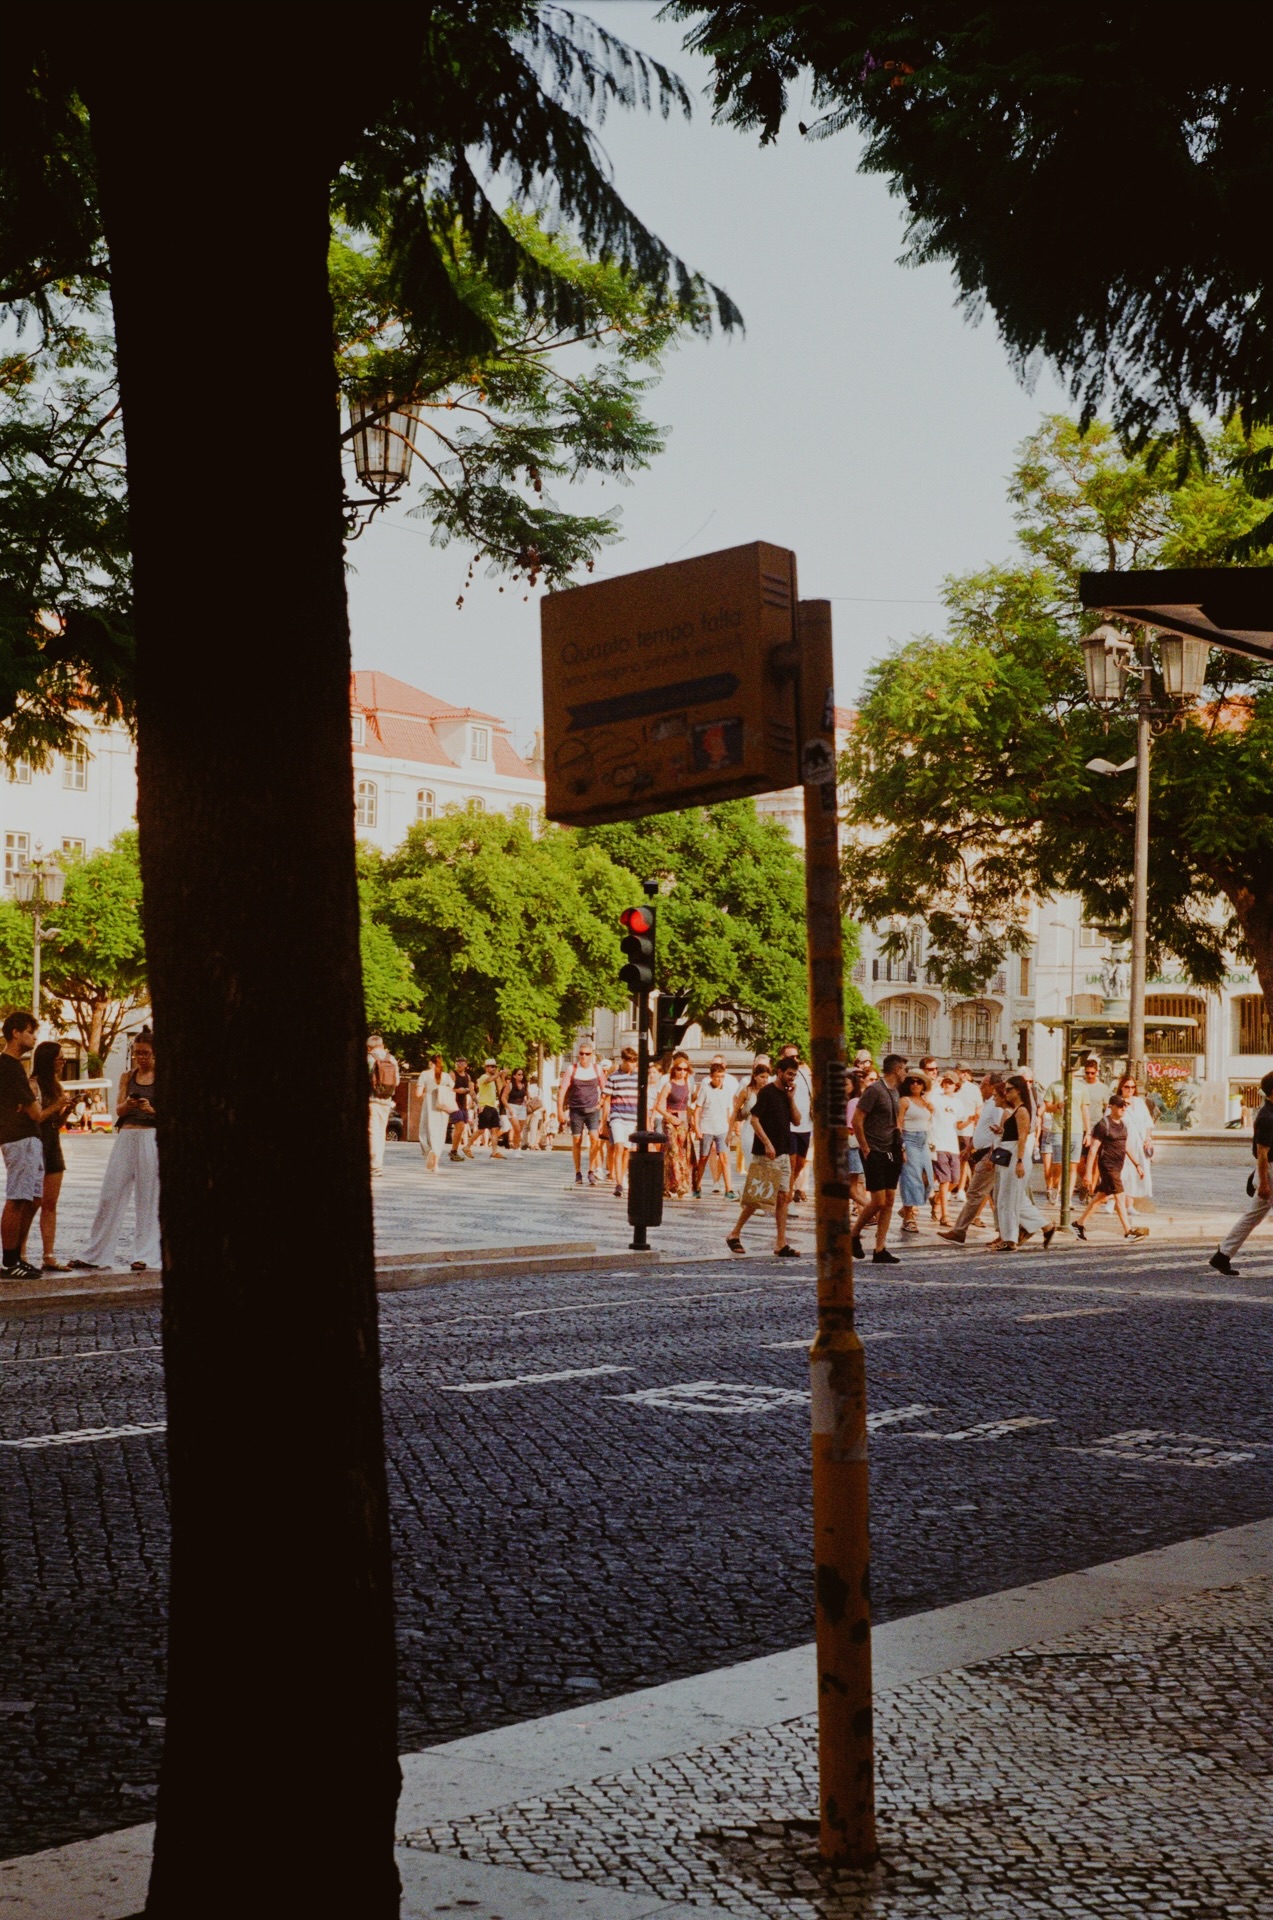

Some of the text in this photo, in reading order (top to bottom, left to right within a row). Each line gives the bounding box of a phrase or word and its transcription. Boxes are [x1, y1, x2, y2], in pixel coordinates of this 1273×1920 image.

[561, 637, 630, 666] Quanto
[637, 621, 693, 647] tempo
[701, 607, 742, 632] falta
